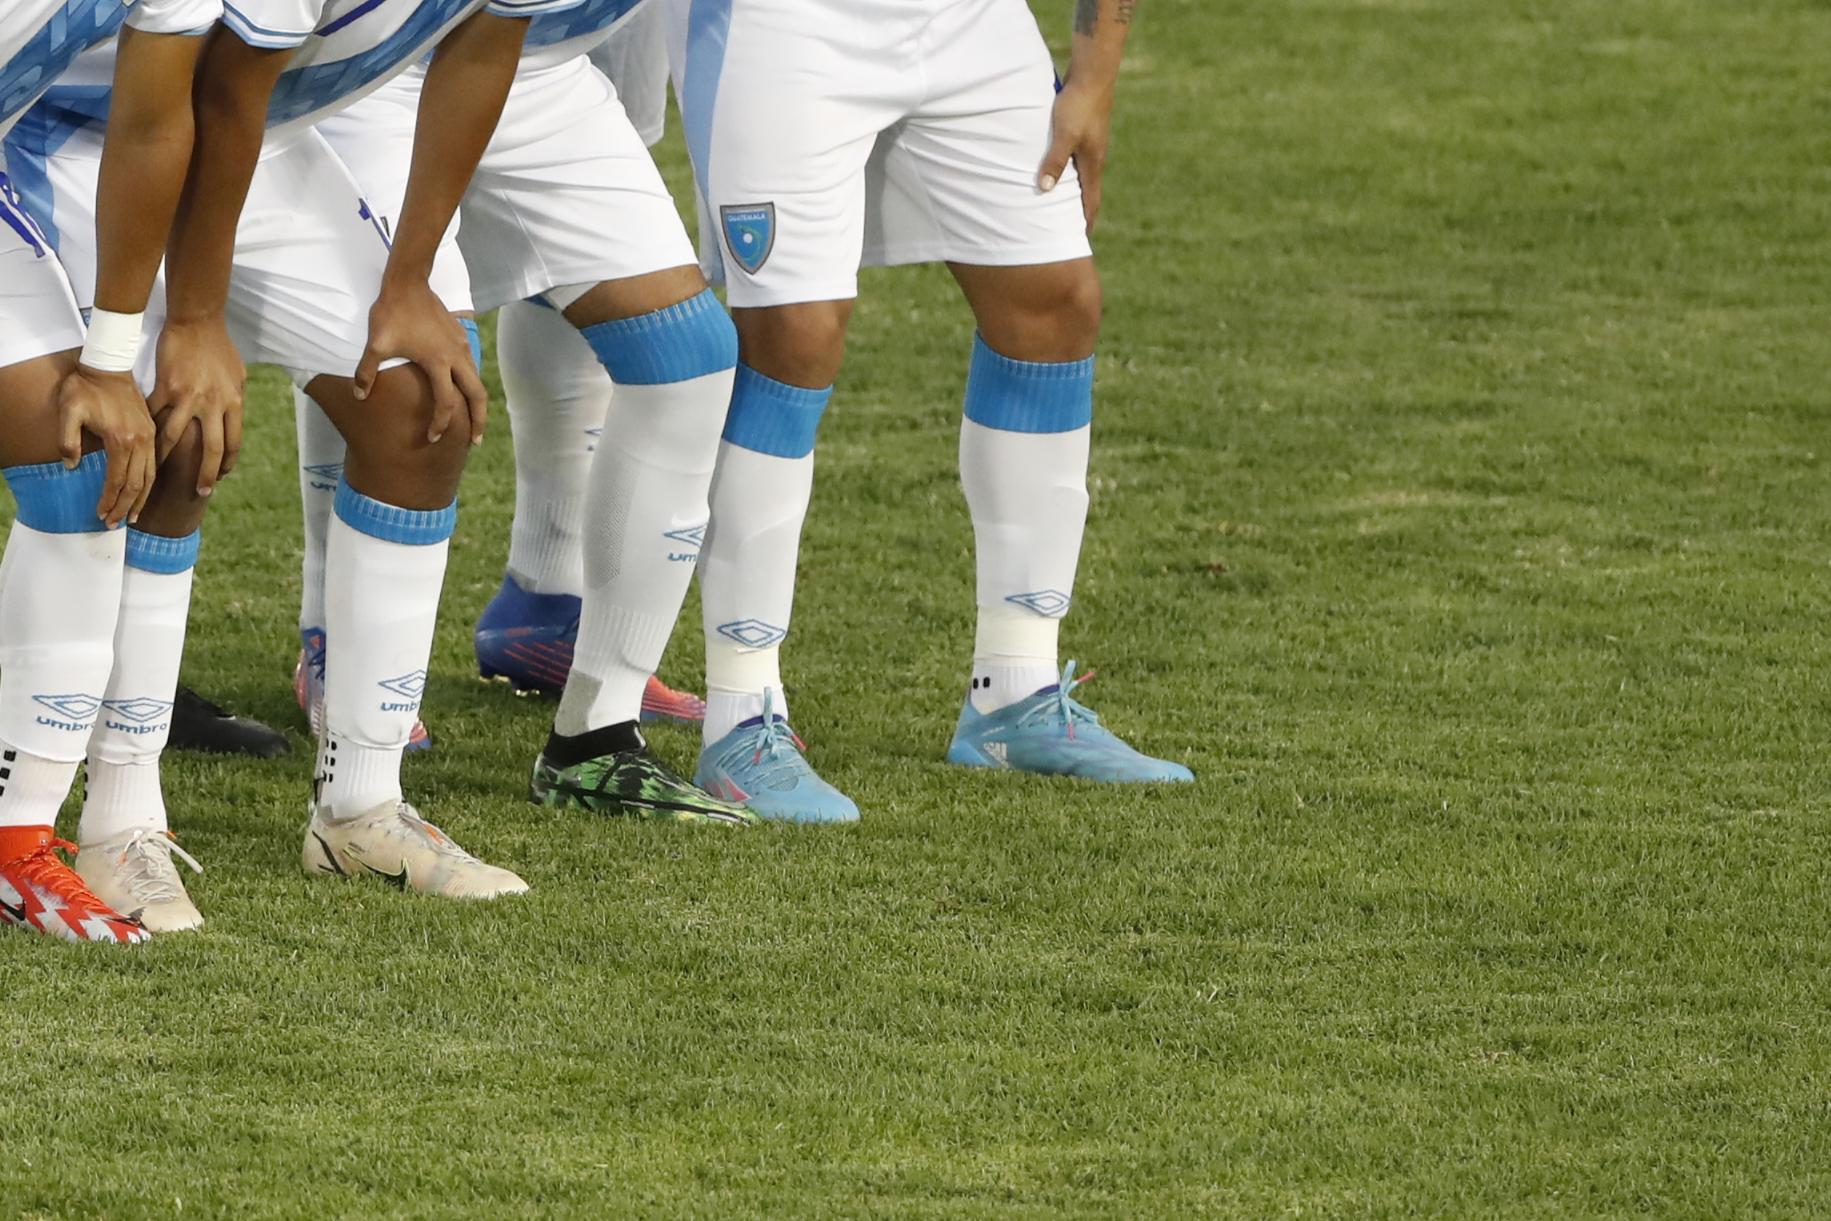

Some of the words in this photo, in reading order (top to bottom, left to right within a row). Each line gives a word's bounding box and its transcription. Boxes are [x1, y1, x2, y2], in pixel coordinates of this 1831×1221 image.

[727, 213, 766, 222] GUATEMALA
[380, 700, 420, 712] umb
[105, 720, 167, 735] umbro
